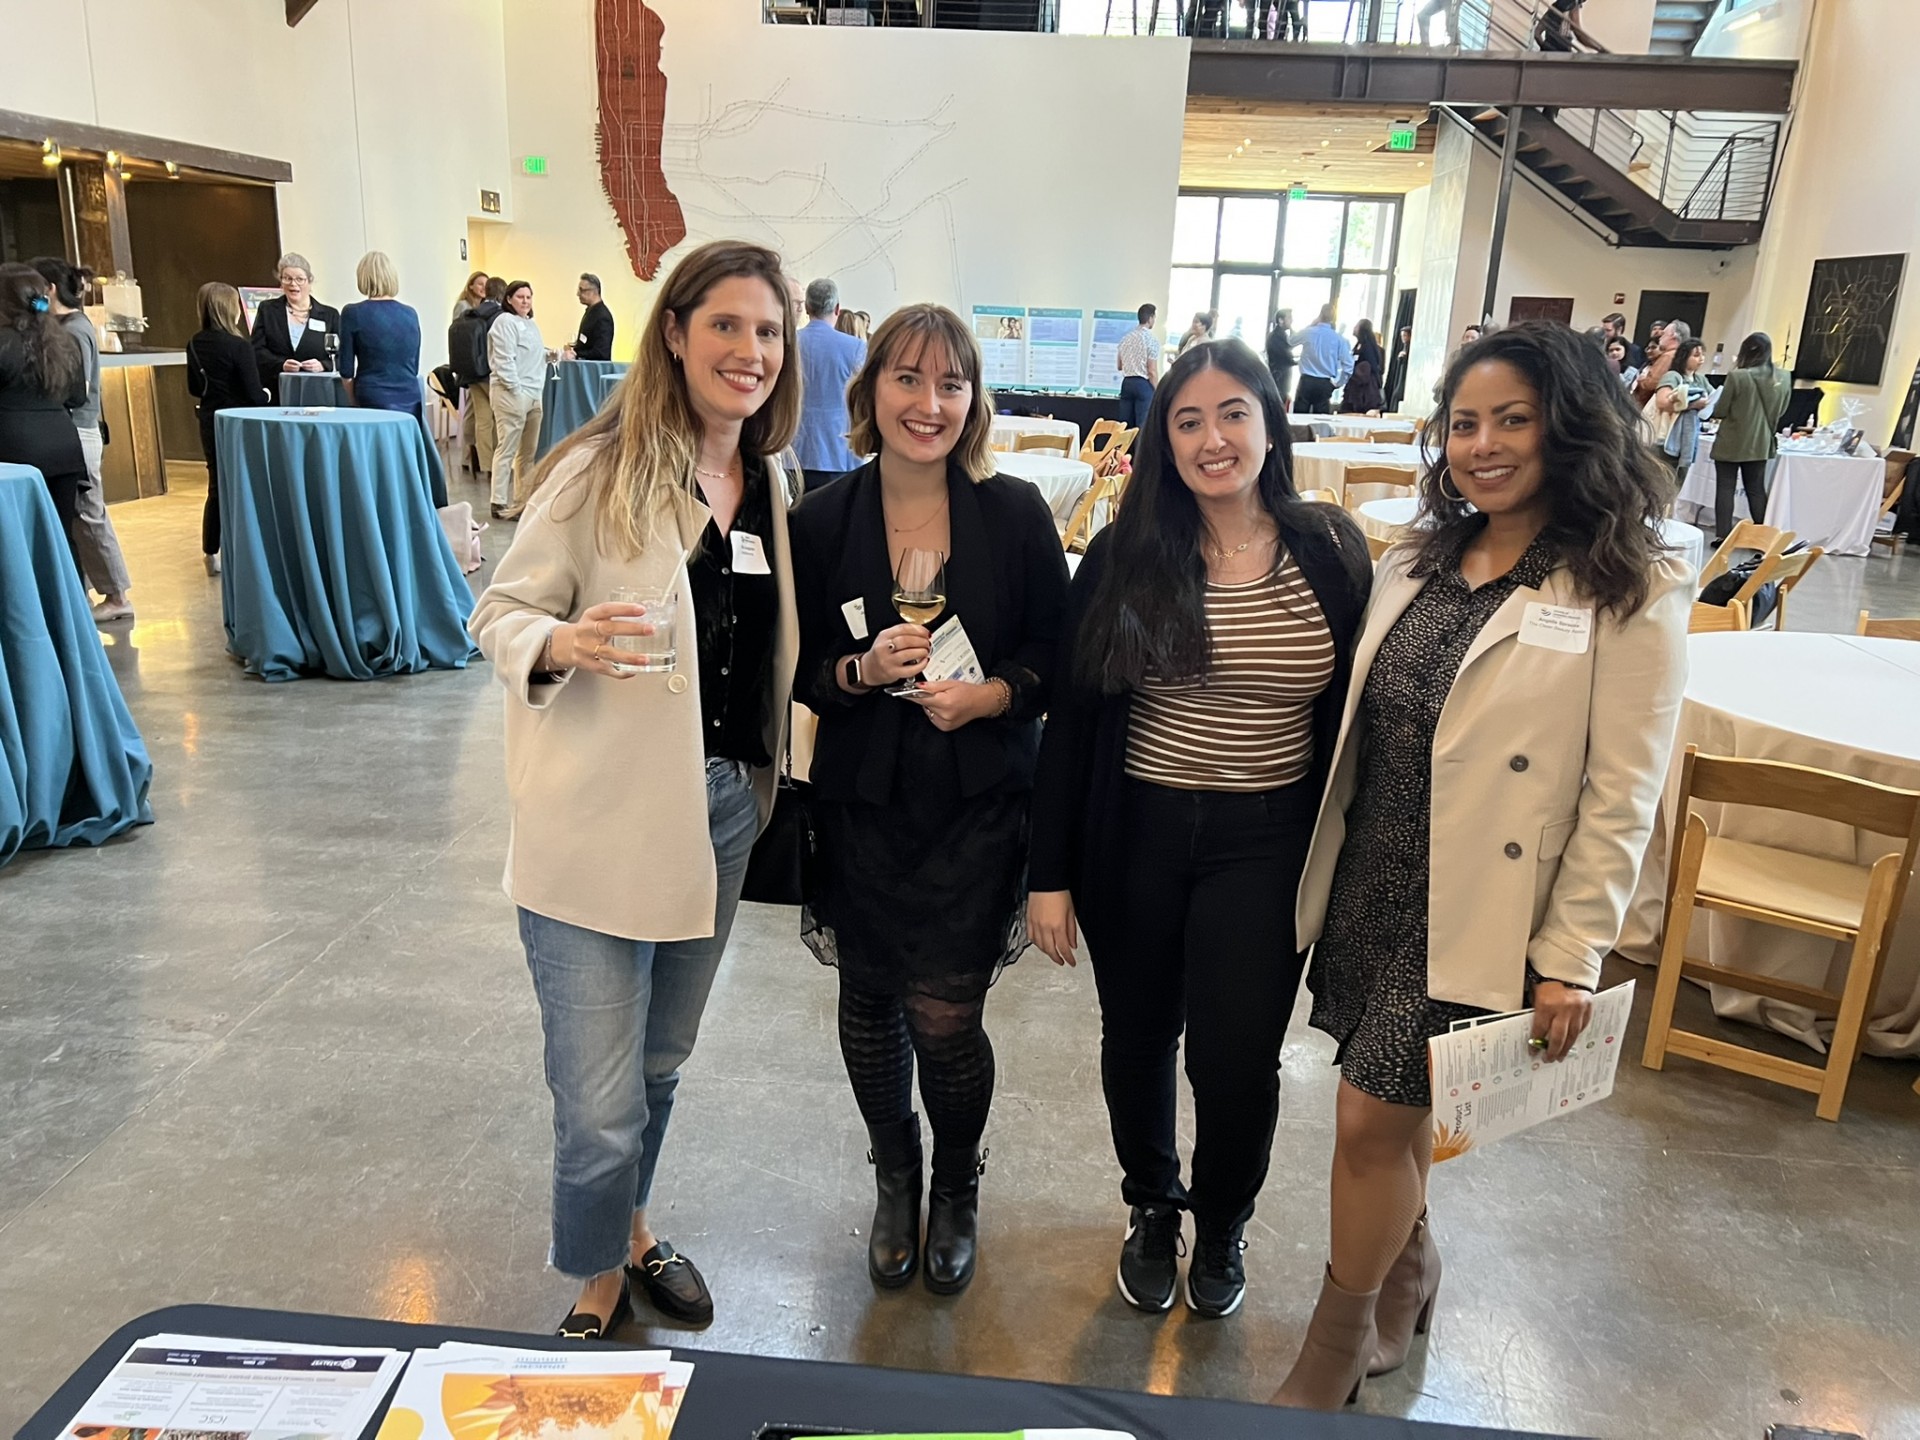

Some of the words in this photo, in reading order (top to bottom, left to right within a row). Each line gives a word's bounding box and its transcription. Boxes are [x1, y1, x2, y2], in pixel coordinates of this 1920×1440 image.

[1392, 132, 1413, 148] EXIT
[1464, 1101, 1473, 1117] List
[1453, 1104, 1463, 1136] Product
[311, 1359, 342, 1367] CATALYST
[198, 1414, 228, 1425] ICSC
